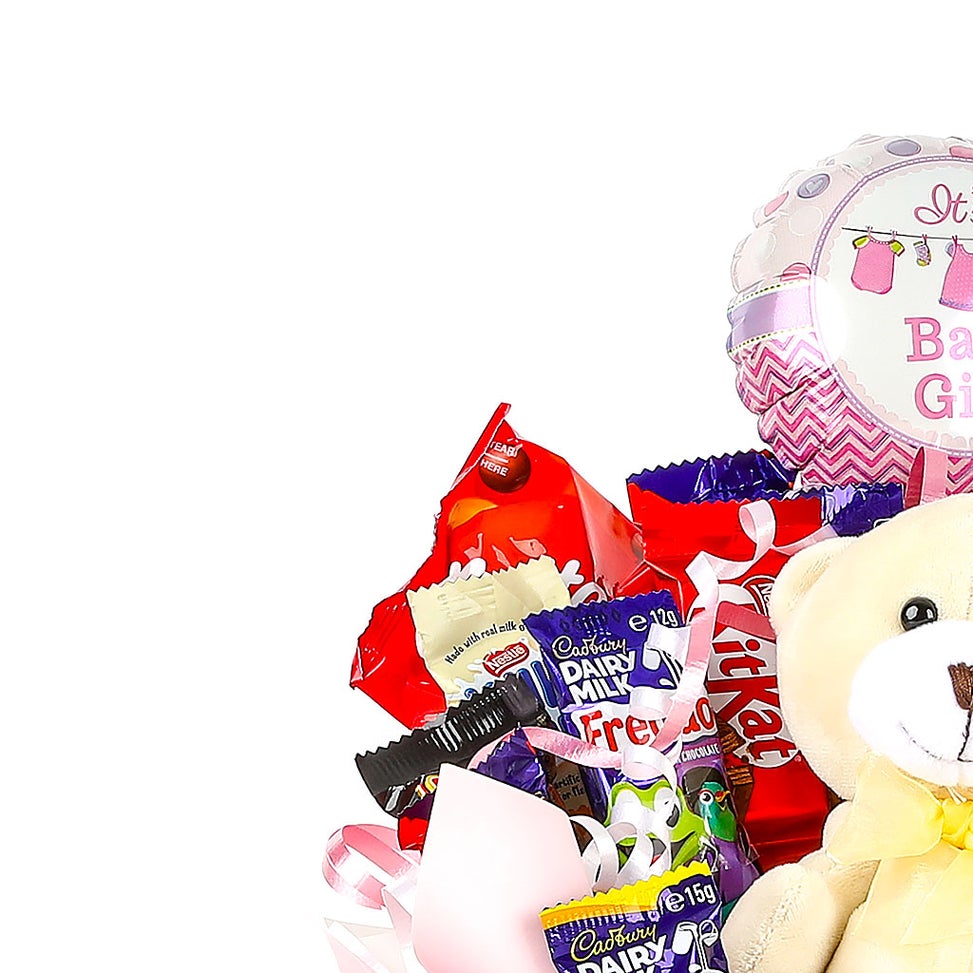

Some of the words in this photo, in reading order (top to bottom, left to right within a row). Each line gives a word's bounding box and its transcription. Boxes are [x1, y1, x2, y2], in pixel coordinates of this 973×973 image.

[480, 459, 508, 477] HERE
[552, 635, 627, 659] Cadbury
[559, 651, 637, 686] DAIRY
[568, 675, 635, 707] MILK
[684, 882, 717, 907] 15g
[570, 924, 658, 963] Cadbury
